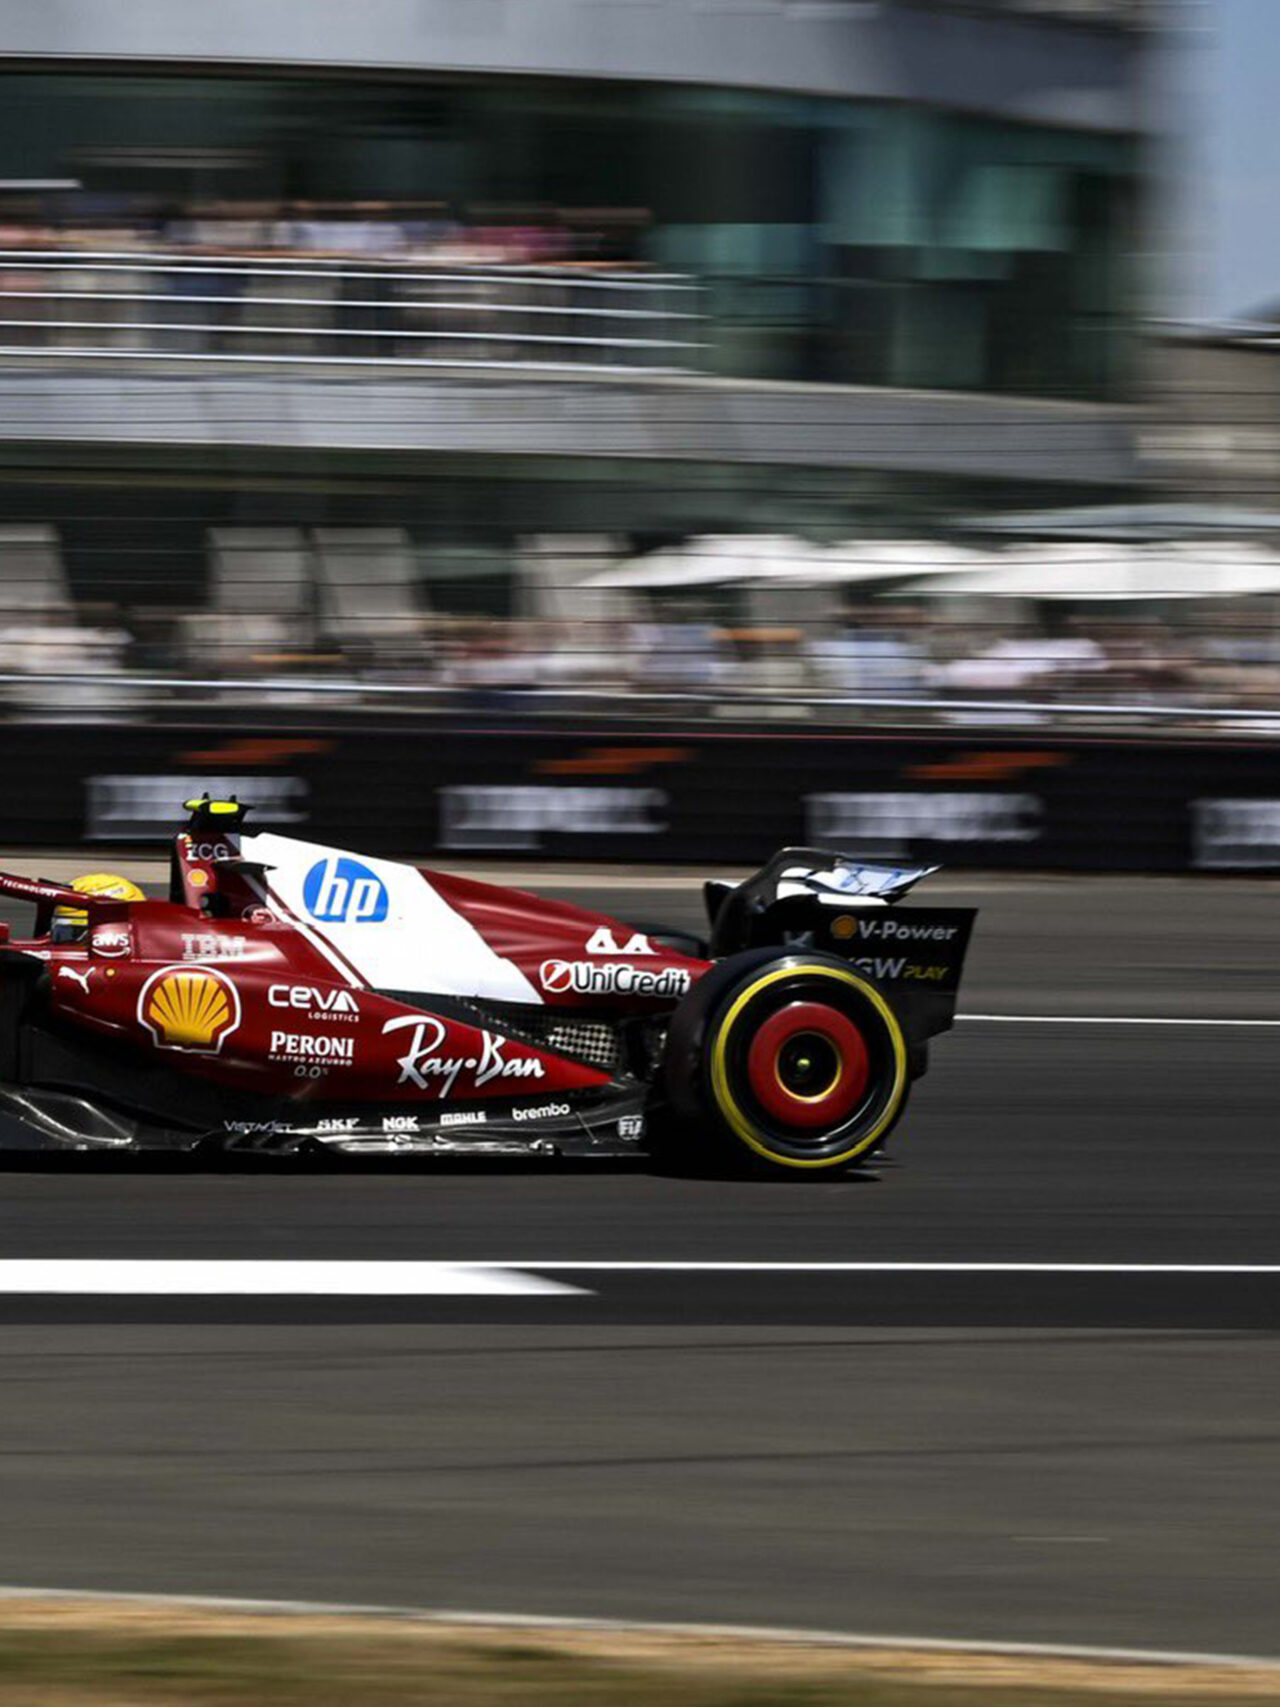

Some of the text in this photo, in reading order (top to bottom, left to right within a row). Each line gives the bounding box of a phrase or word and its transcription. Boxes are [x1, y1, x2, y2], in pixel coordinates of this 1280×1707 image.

[311, 857, 382, 922] hp
[91, 932, 130, 947] aws
[859, 920, 958, 940] V-Power
[181, 933, 246, 960] IBM
[850, 957, 949, 980] GW PLAY
[570, 960, 691, 998] UniCredit
[308, 1011, 360, 1023] LOGISTICS
[269, 1030, 355, 1057] PERONI
[440, 1111, 488, 1126] MAHLE
[512, 1103, 571, 1121] brembo
[317, 1117, 361, 1131] SKF
[381, 1116, 420, 1132] NGK
